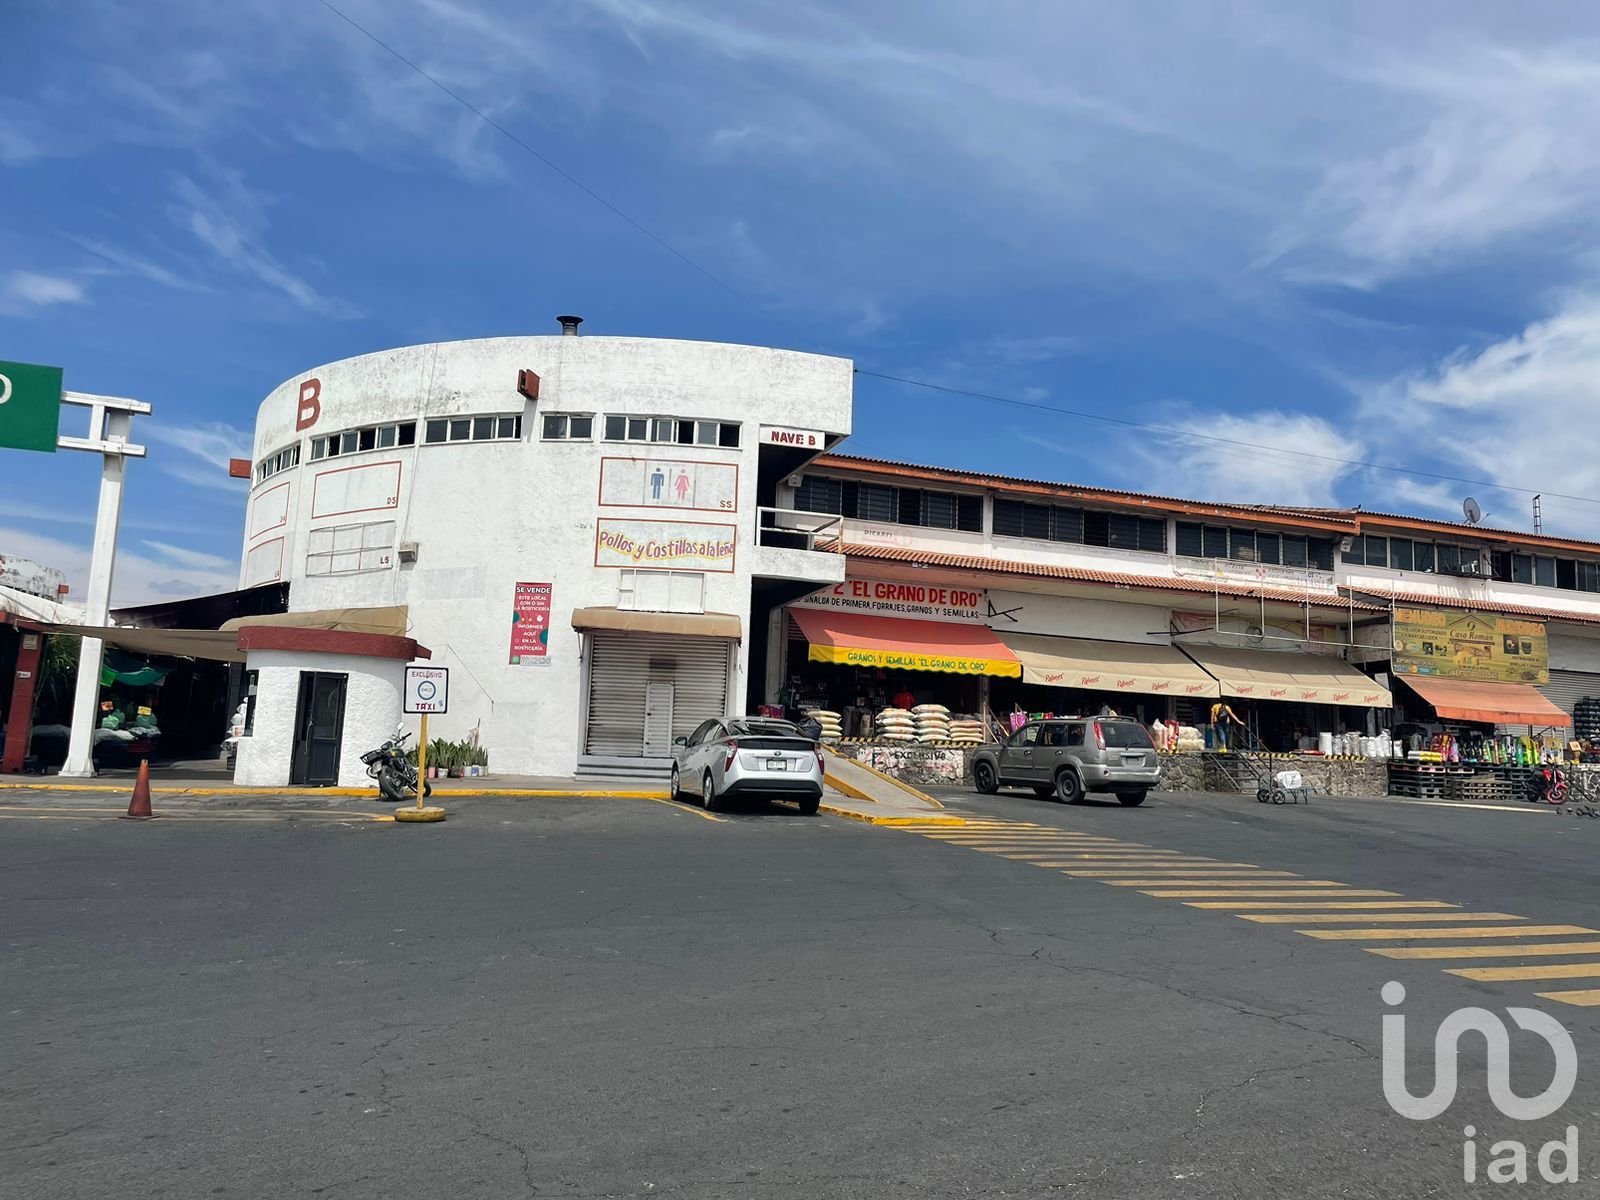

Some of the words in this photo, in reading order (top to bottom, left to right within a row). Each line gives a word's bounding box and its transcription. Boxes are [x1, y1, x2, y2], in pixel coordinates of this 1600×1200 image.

[296, 378, 321, 432] B
[771, 431, 804, 444] NAVE
[808, 435, 816, 446] B
[600, 531, 634, 553] Pollos
[633, 545, 645, 559] y
[646, 541, 698, 558] Costillas
[875, 583, 925, 602] GRANO
[928, 588, 947, 604] DE
[831, 597, 841, 607] DE
[934, 607, 941, 615] Y
[943, 608, 979, 619] SEMILLAS
[1450, 630, 1467, 639] Casa
[847, 652, 877, 663] GRANOS
[878, 655, 884, 663] Y
[885, 656, 917, 666] SEMILLAS
[930, 659, 956, 669] GRANO
[957, 661, 968, 670] DE
[415, 702, 436, 711] TAXI
